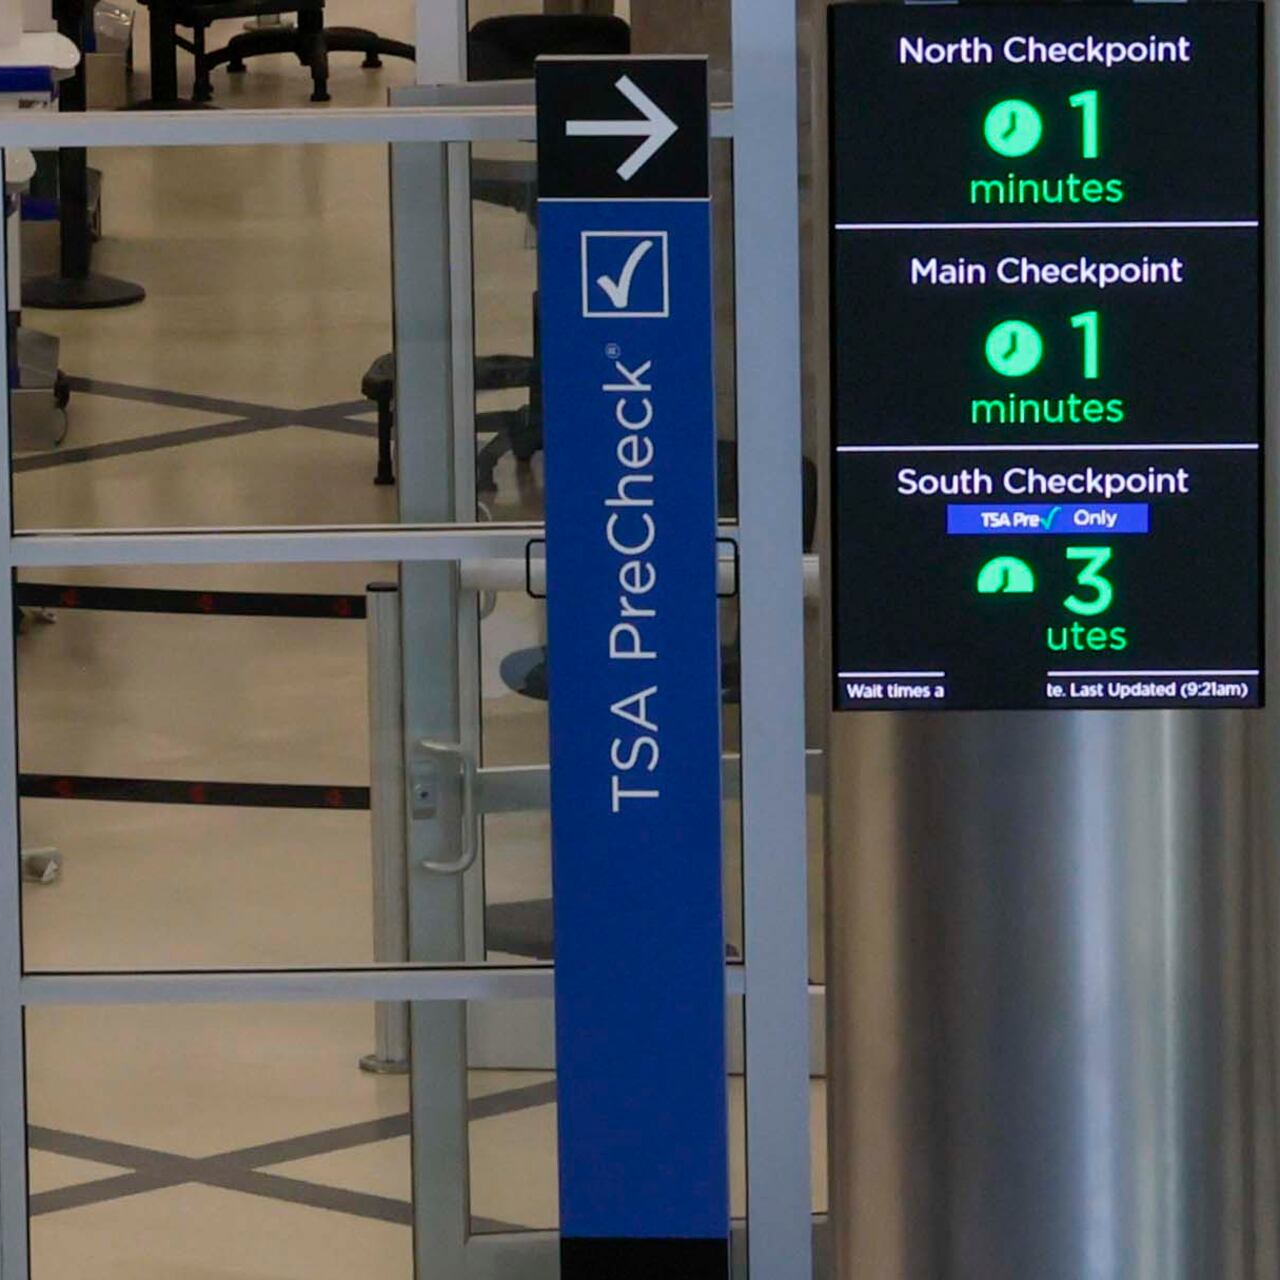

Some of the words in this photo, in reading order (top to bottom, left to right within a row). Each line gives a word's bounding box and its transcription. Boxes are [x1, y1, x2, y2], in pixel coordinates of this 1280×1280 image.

[900, 36, 993, 64] North
[1003, 35, 1190, 67] Checkpoint
[1069, 89, 1100, 159] 1
[970, 172, 1124, 204] minutes
[911, 258, 986, 285] Main
[996, 256, 1183, 289] Checkpoint
[1070, 310, 1100, 379] 1
[971, 392, 1125, 424] minutes
[897, 468, 993, 495] South
[1003, 467, 1189, 499] Checkpoint
[981, 512, 1011, 529] TSA
[1073, 508, 1118, 529] Only
[1062, 545, 1114, 618] 3
[846, 683, 884, 699] Wait
[887, 683, 931, 699] times
[1070, 682, 1104, 698] Last
[1107, 681, 1177, 699] Updated
[609, 684, 660, 814] TSA
